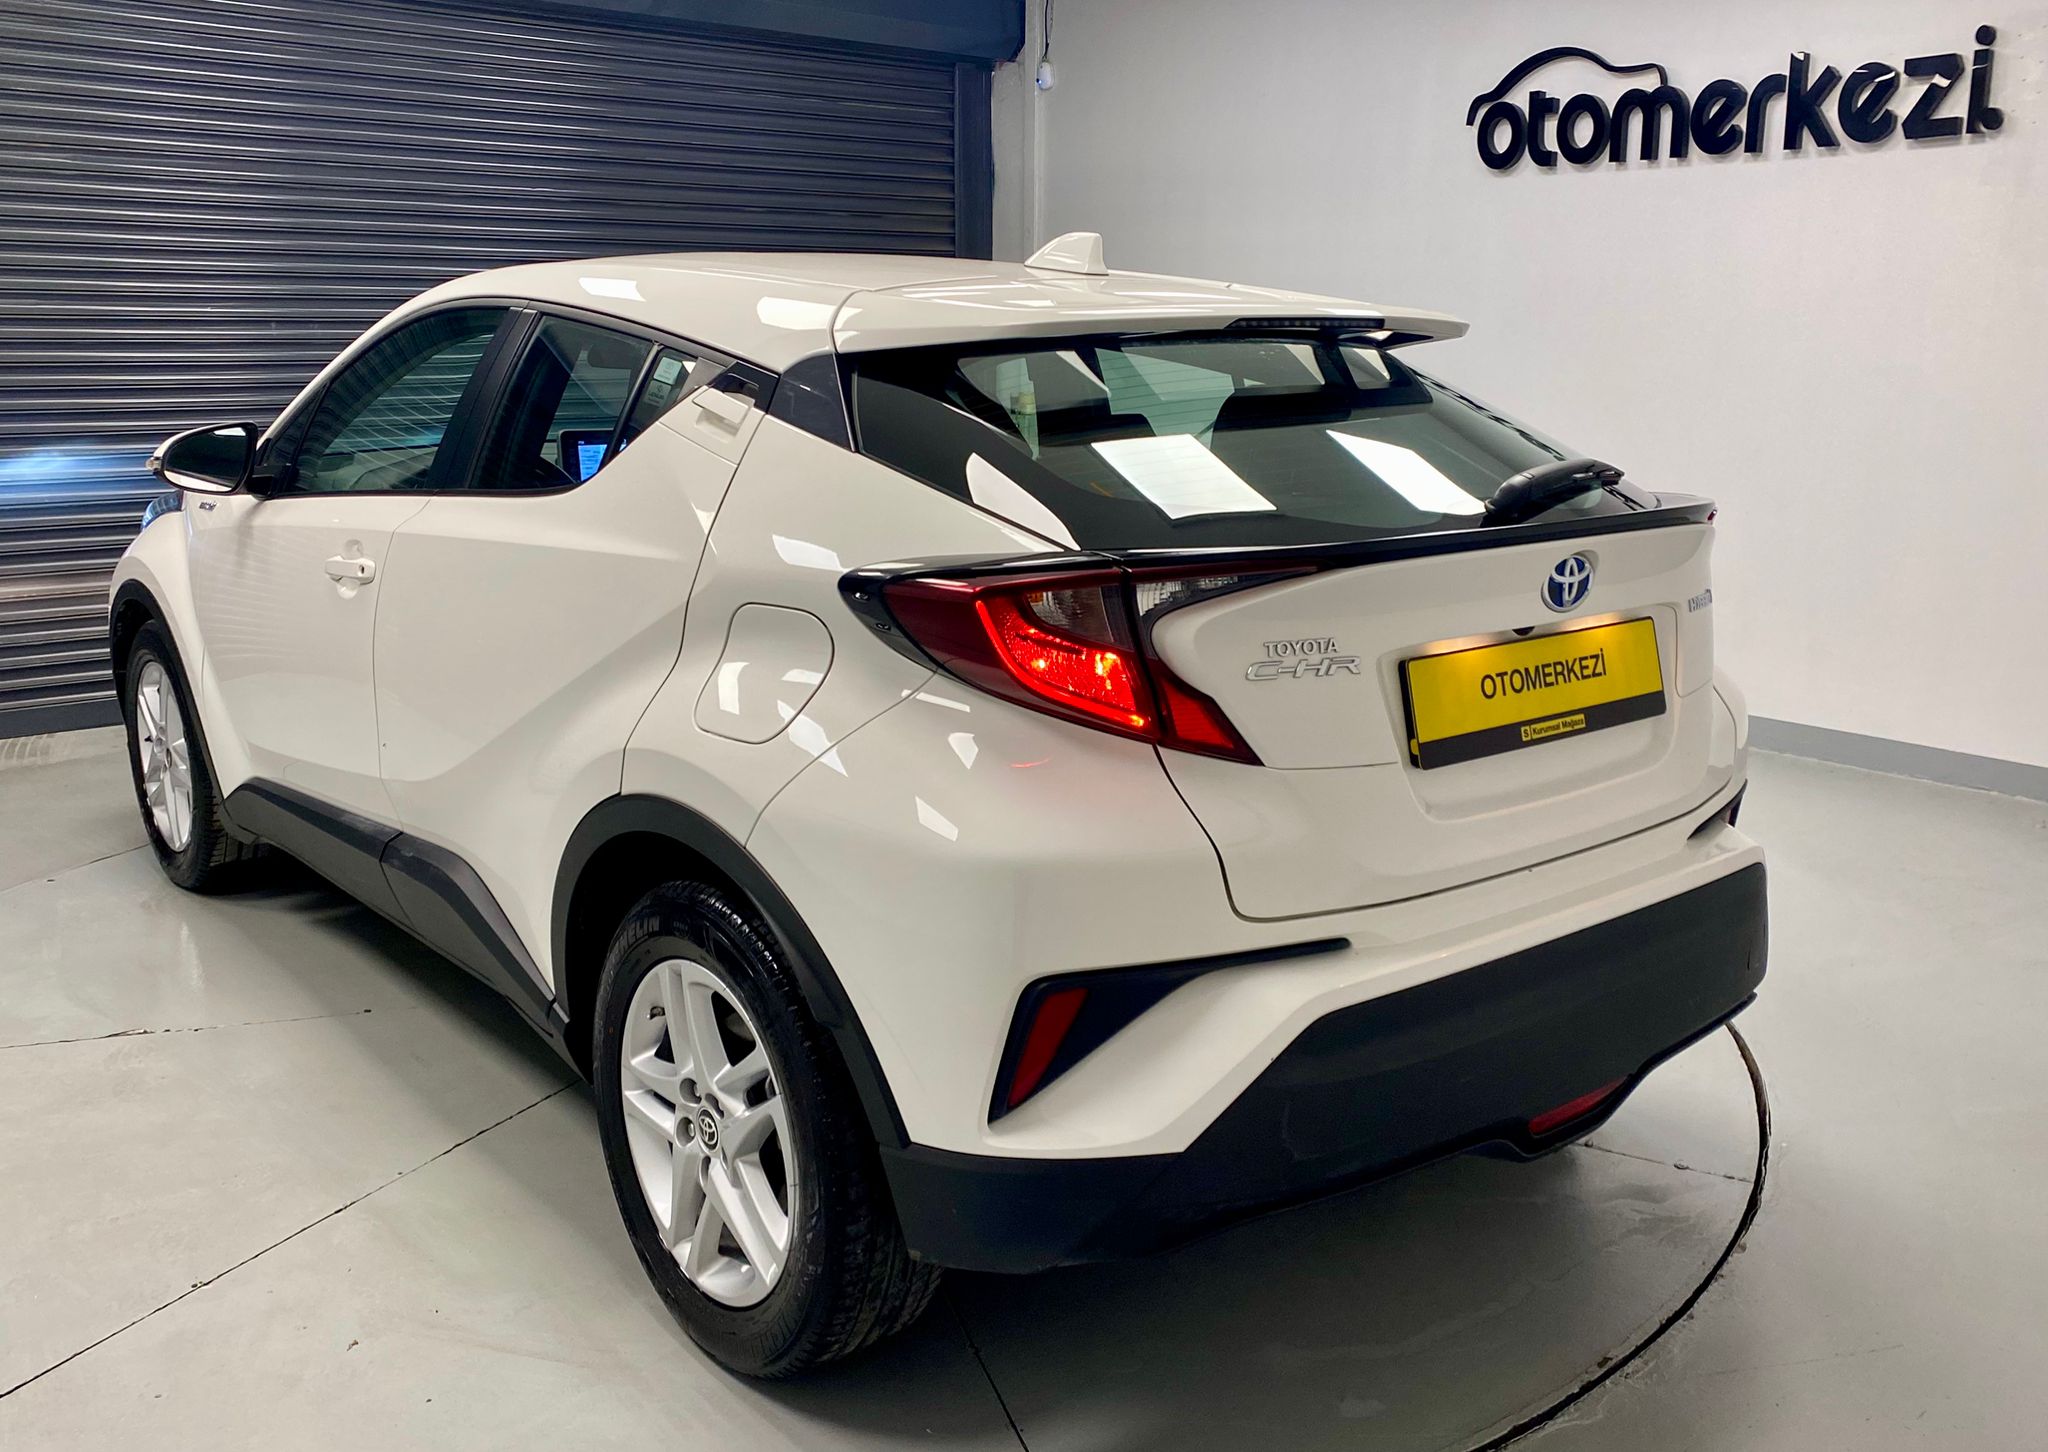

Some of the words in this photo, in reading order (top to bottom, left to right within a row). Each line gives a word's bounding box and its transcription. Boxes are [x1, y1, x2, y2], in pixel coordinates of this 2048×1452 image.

[1264, 637, 1339, 658] TOYOTA
[1246, 656, 1361, 681] C-HR
[1481, 648, 1606, 699] OTOMERKEZİ
